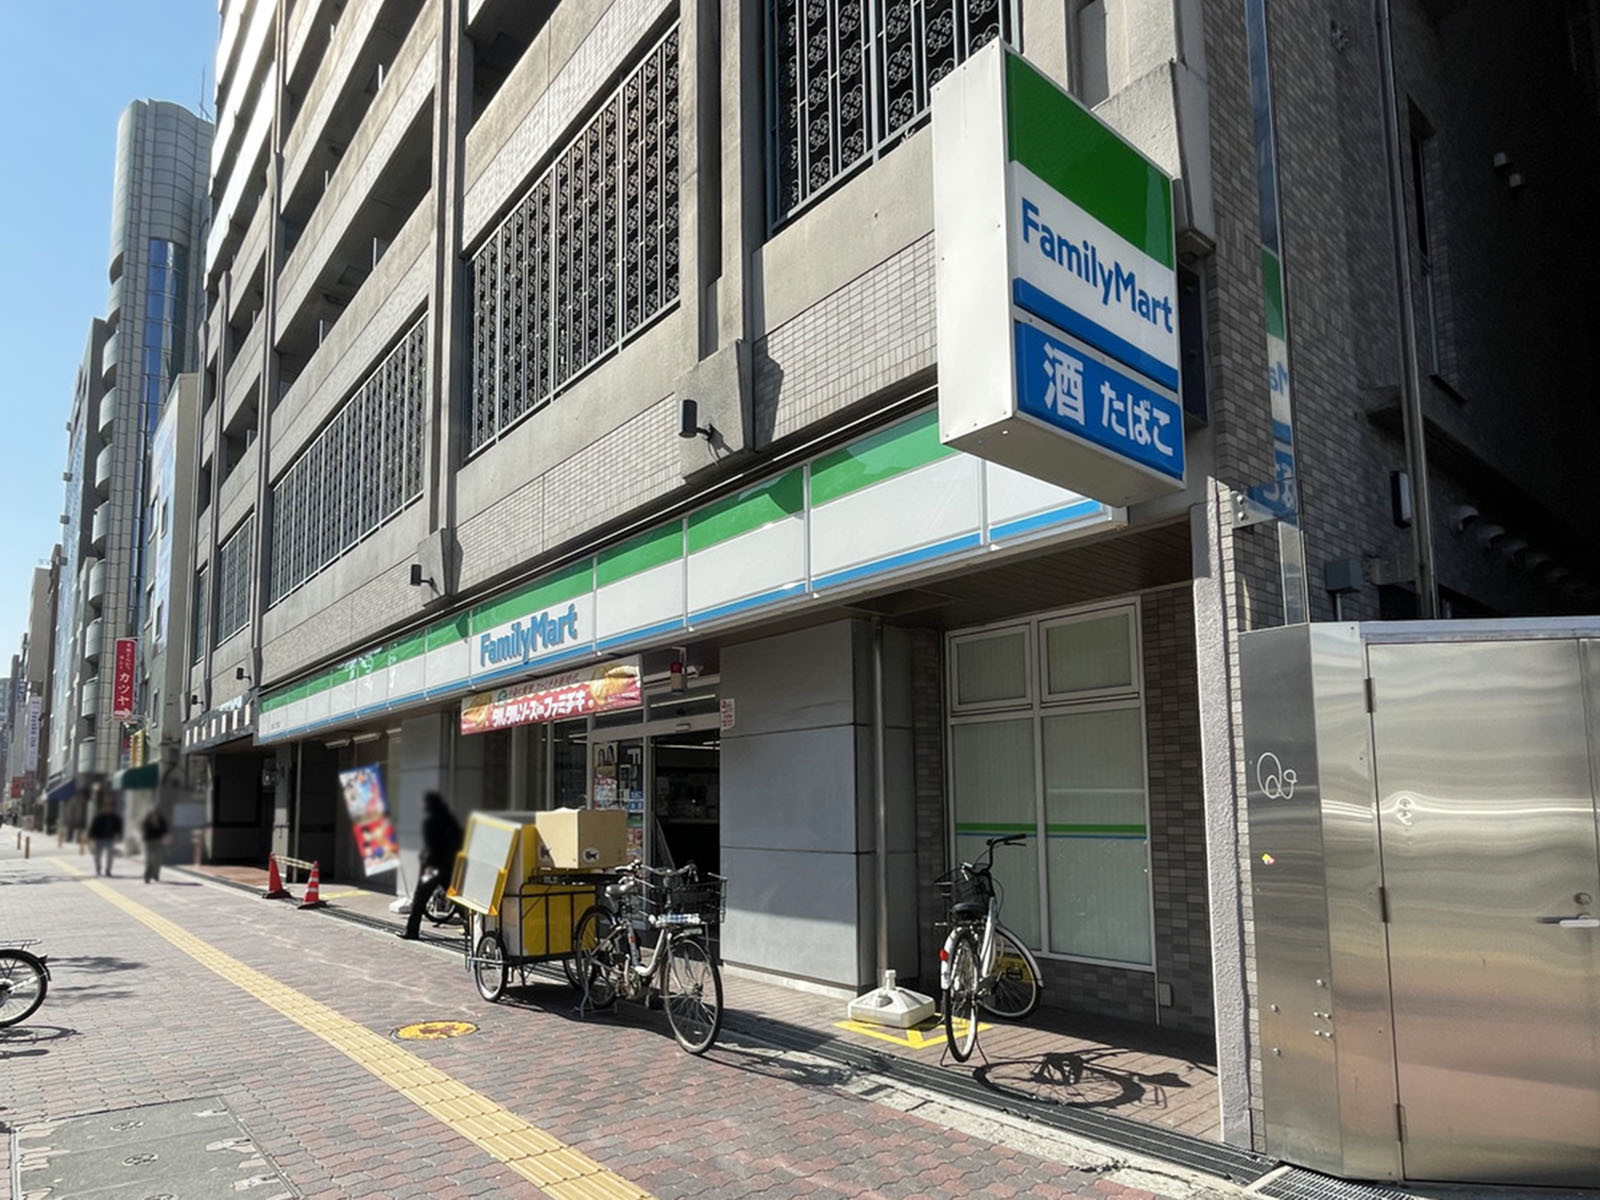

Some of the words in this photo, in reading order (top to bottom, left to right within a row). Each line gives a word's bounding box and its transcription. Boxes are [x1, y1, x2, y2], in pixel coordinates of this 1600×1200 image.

[1022, 197, 1173, 334] FamilyMart
[1043, 342, 1085, 426] 酒
[1100, 380, 1174, 456] たばこ
[480, 603, 578, 668] FamilyMart
